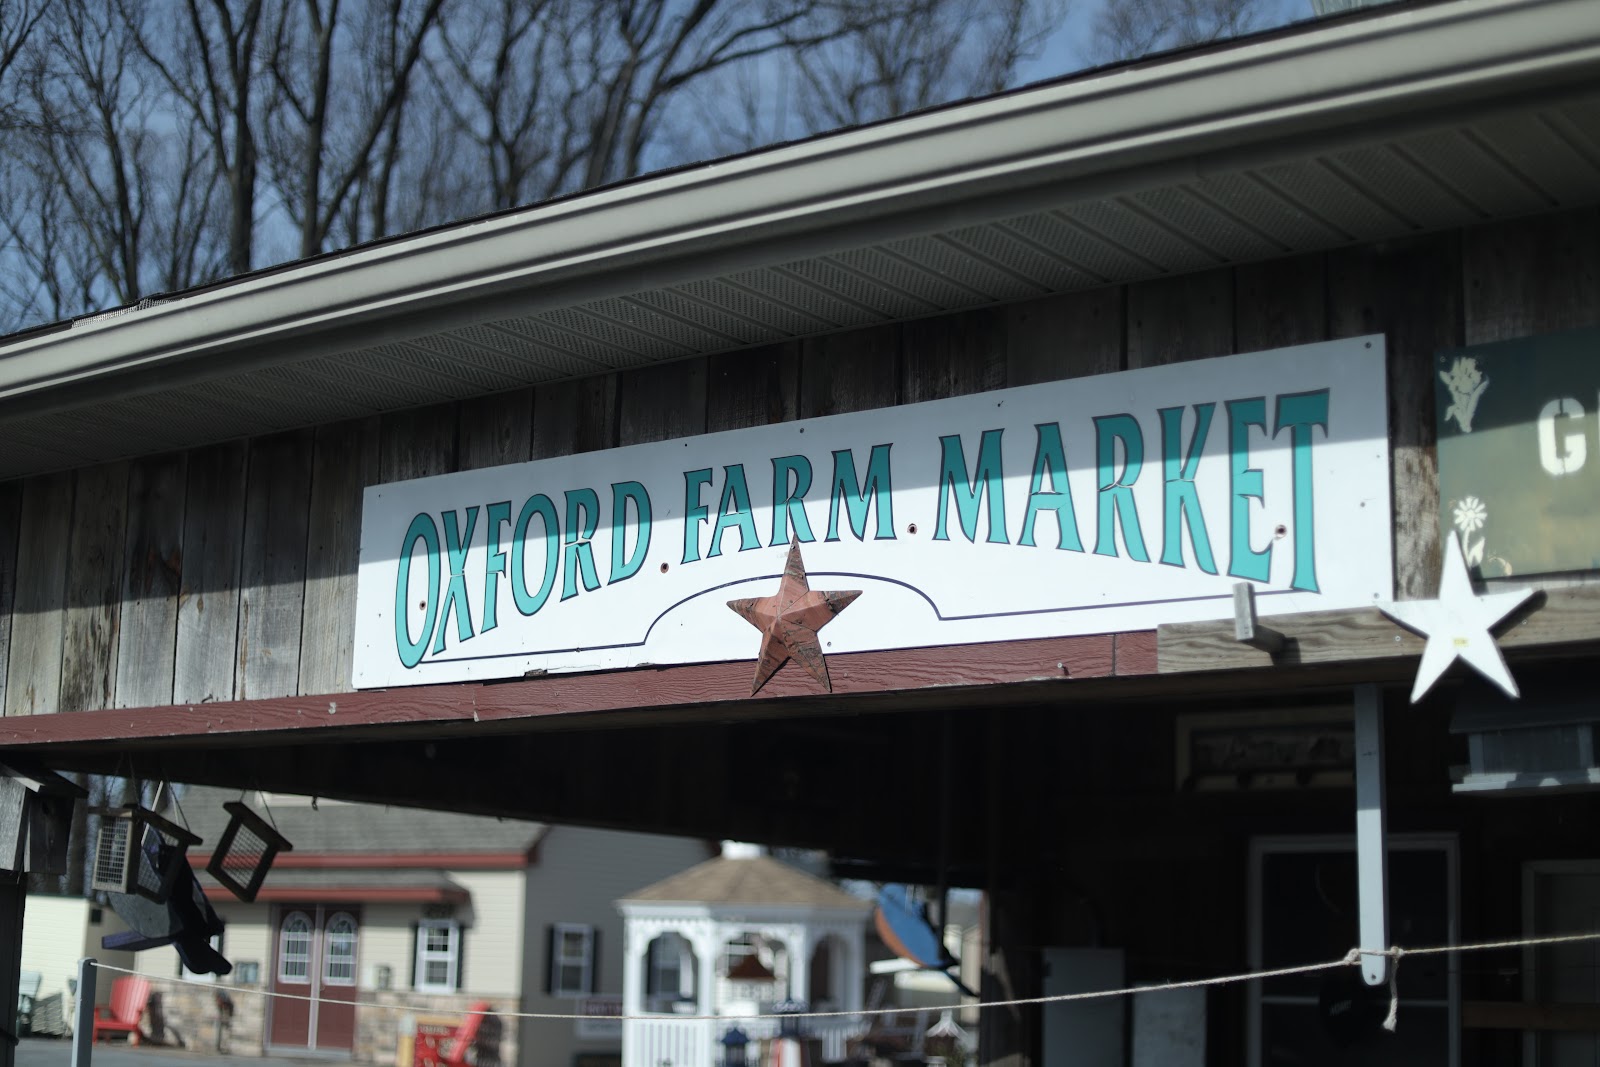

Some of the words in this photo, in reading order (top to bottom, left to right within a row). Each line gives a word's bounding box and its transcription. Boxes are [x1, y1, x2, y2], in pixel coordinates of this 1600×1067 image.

[1537, 391, 1600, 476] G
[395, 480, 652, 669] OXFORD
[681, 443, 898, 565] FARM
[932, 387, 1330, 595] MARKET
